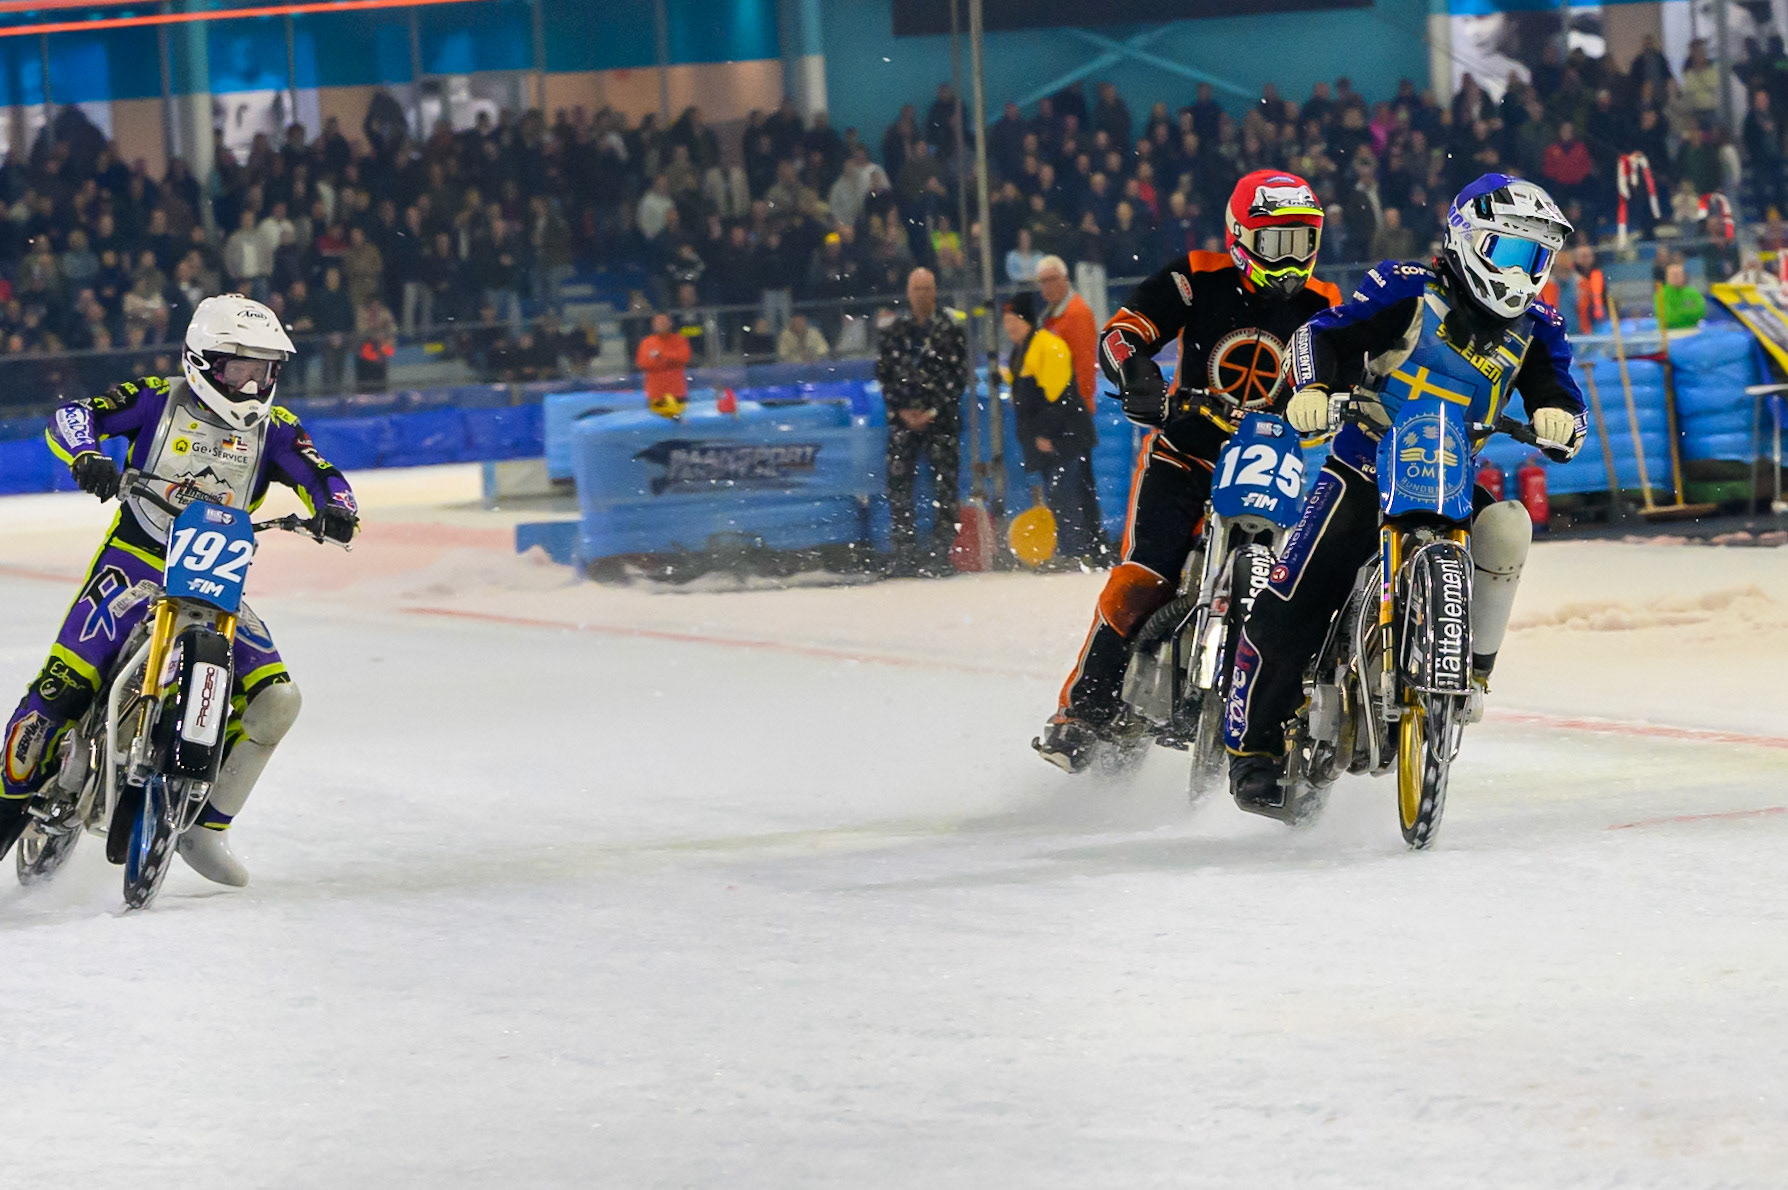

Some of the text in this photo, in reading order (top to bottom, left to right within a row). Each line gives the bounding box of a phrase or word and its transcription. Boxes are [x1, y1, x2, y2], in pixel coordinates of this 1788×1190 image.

[1436, 322, 1503, 386] SEDEN
[1219, 444, 1304, 499] 125
[1241, 492, 1278, 511] FIM
[168, 527, 254, 583] 192
[186, 578, 225, 598] FIM
